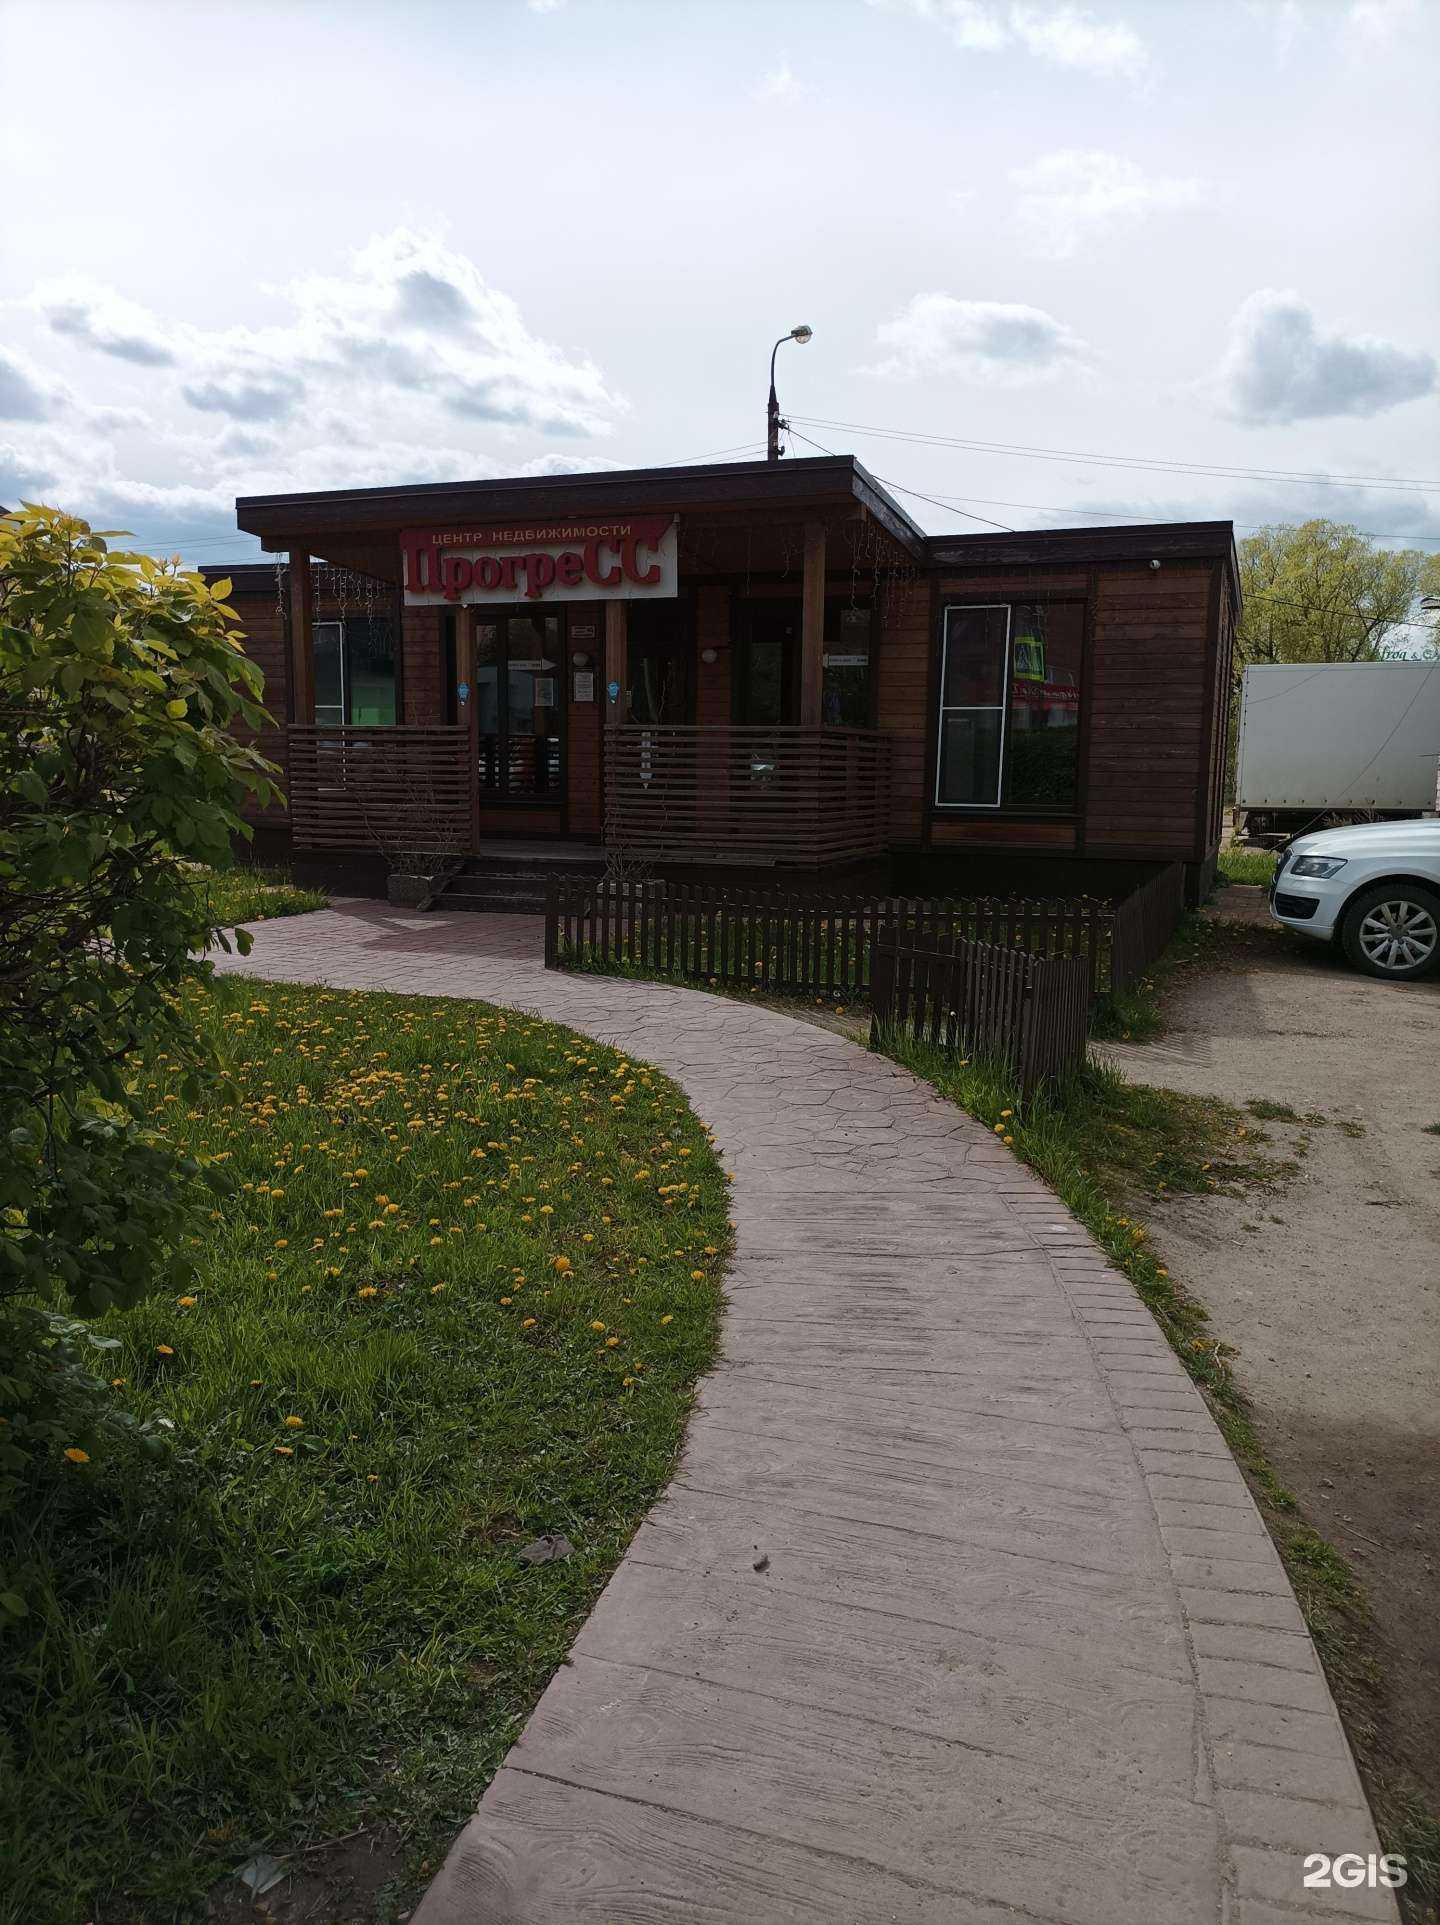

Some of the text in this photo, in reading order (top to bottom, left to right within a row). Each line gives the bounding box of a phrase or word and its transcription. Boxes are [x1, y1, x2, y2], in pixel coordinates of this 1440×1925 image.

[431, 525, 632, 545] ЦЕНТР НЕДВИЖИМОСТИ
[405, 538, 661, 600] ПрогреСС
